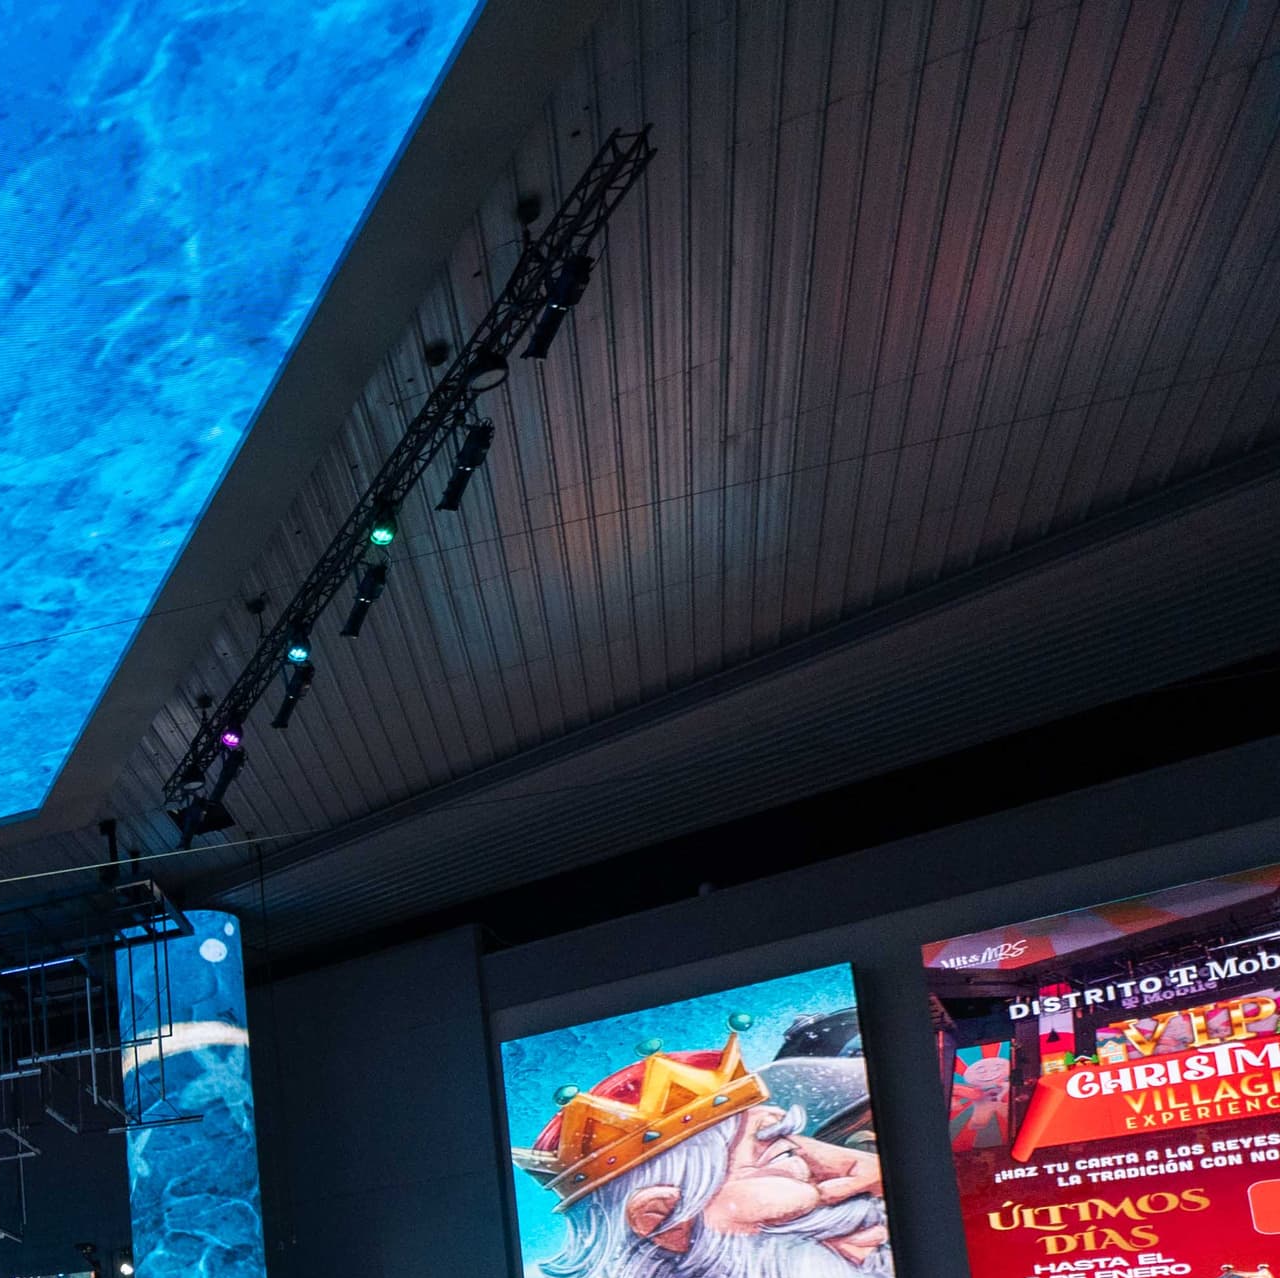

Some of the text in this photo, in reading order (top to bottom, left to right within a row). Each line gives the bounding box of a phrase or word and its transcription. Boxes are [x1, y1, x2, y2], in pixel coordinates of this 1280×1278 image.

[1008, 976, 1162, 1020] DISTRITO
[1206, 951, 1280, 982] Mob
[1108, 996, 1277, 1056] VIP
[1066, 1042, 1280, 1099] CHRISTM
[1125, 1095, 1280, 1129] EXPERIENC
[994, 1134, 1280, 1184] ¡HAZ TU CARTA A LOS REYES
[1057, 1149, 1280, 1187] LA TRADICIÓN CON NO
[987, 1188, 1211, 1232] ÚLTIMOS
[1036, 1224, 1160, 1256] DÍAS
[1033, 1252, 1175, 1275] HASTA EL
